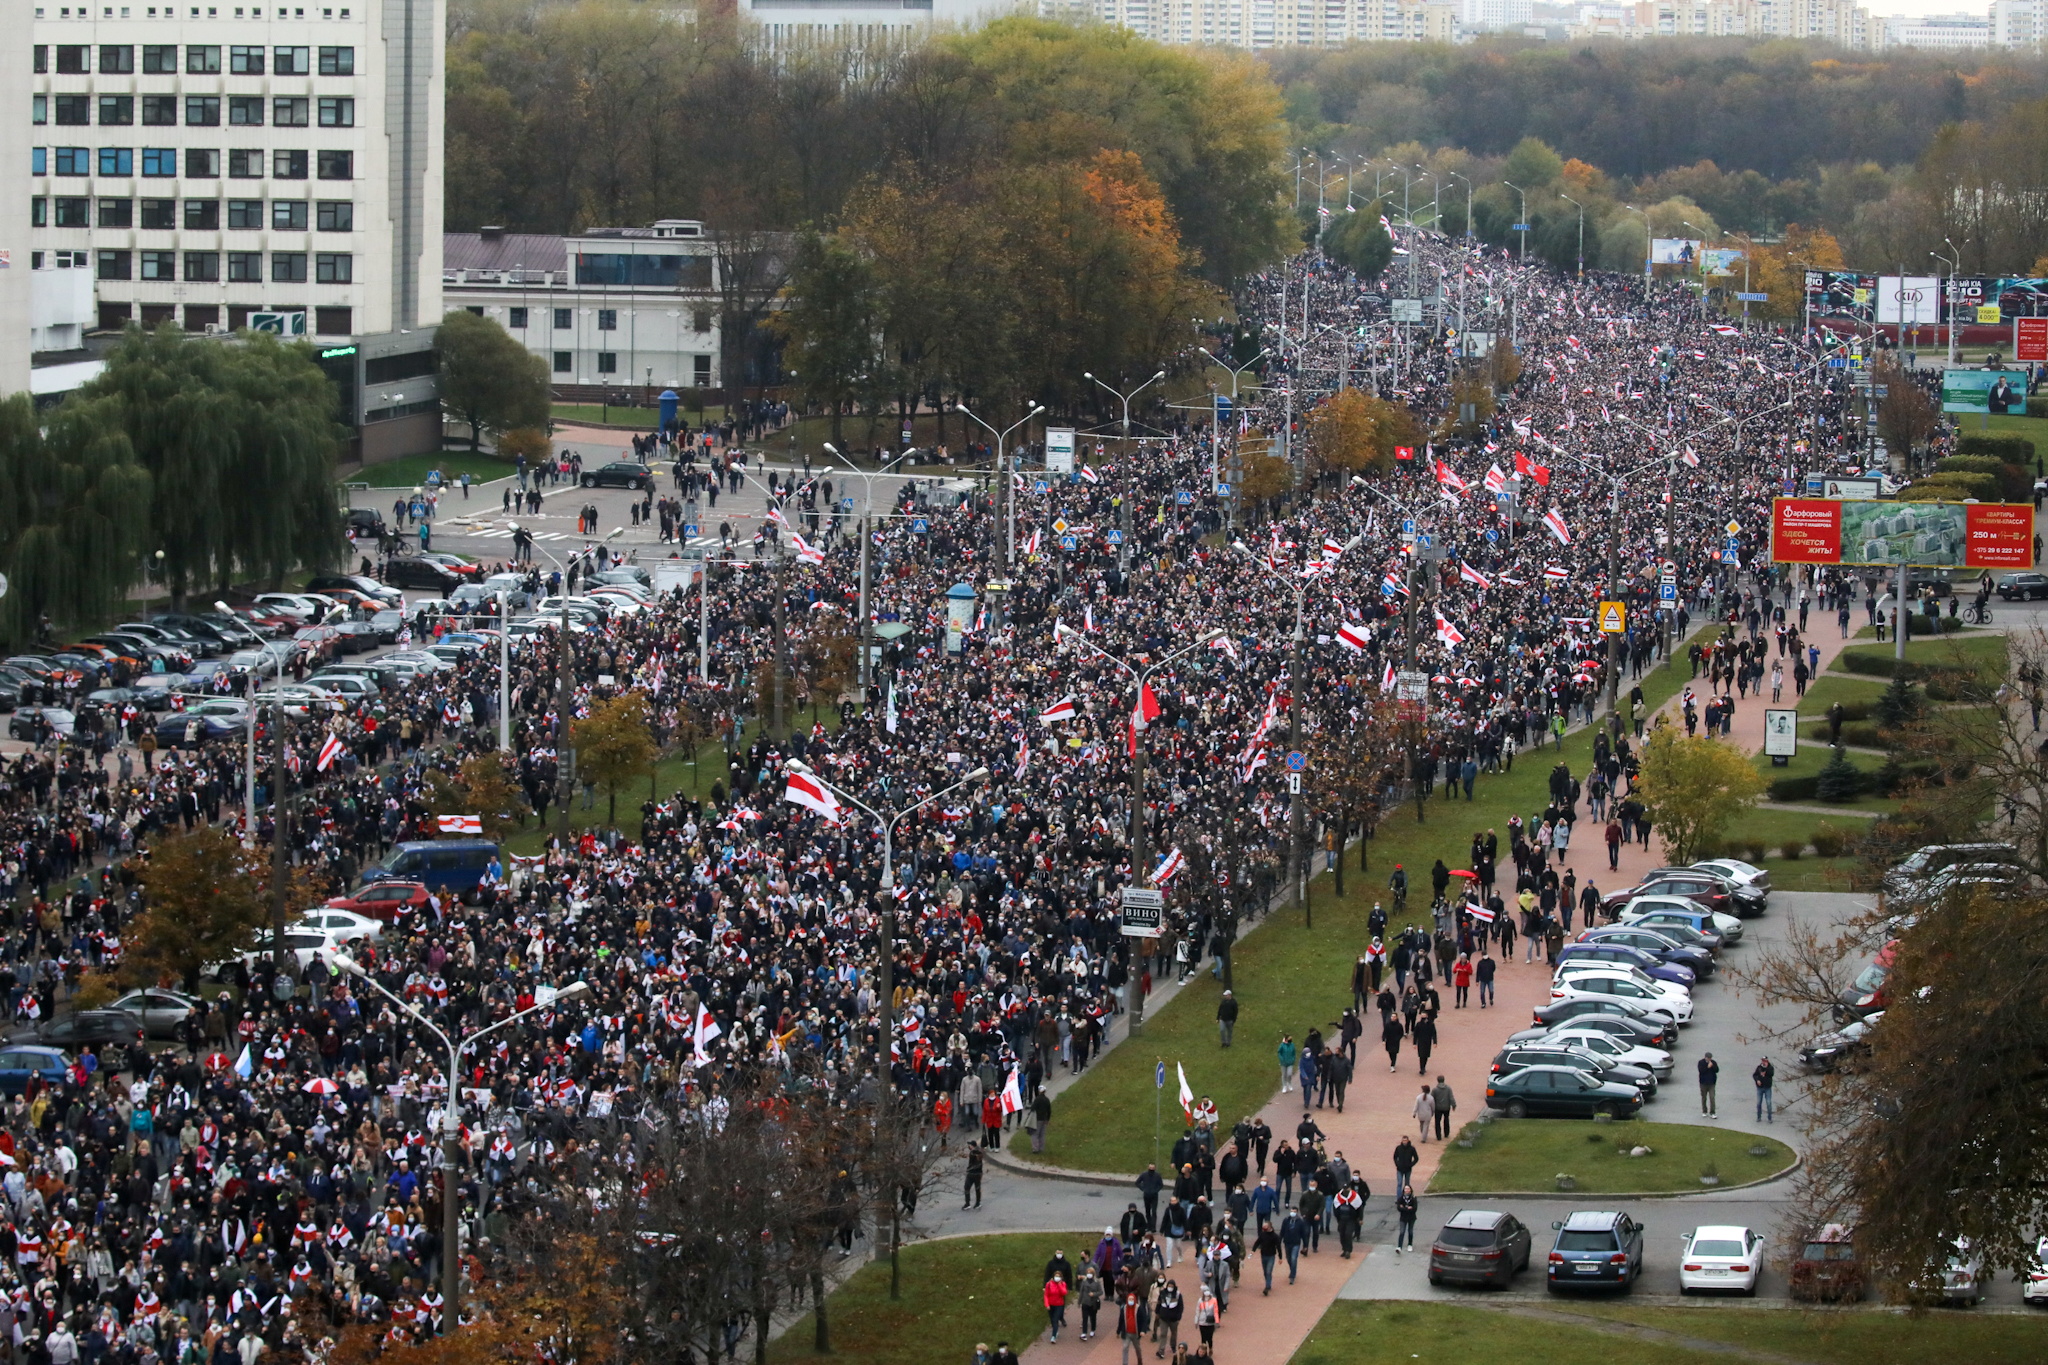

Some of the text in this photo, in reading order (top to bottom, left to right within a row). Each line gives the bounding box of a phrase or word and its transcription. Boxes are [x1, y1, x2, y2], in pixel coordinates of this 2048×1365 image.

[1783, 505, 1832, 518] Фарфоровый
[1664, 586, 1672, 598] P
[1126, 908, 1158, 918] ВИНО
